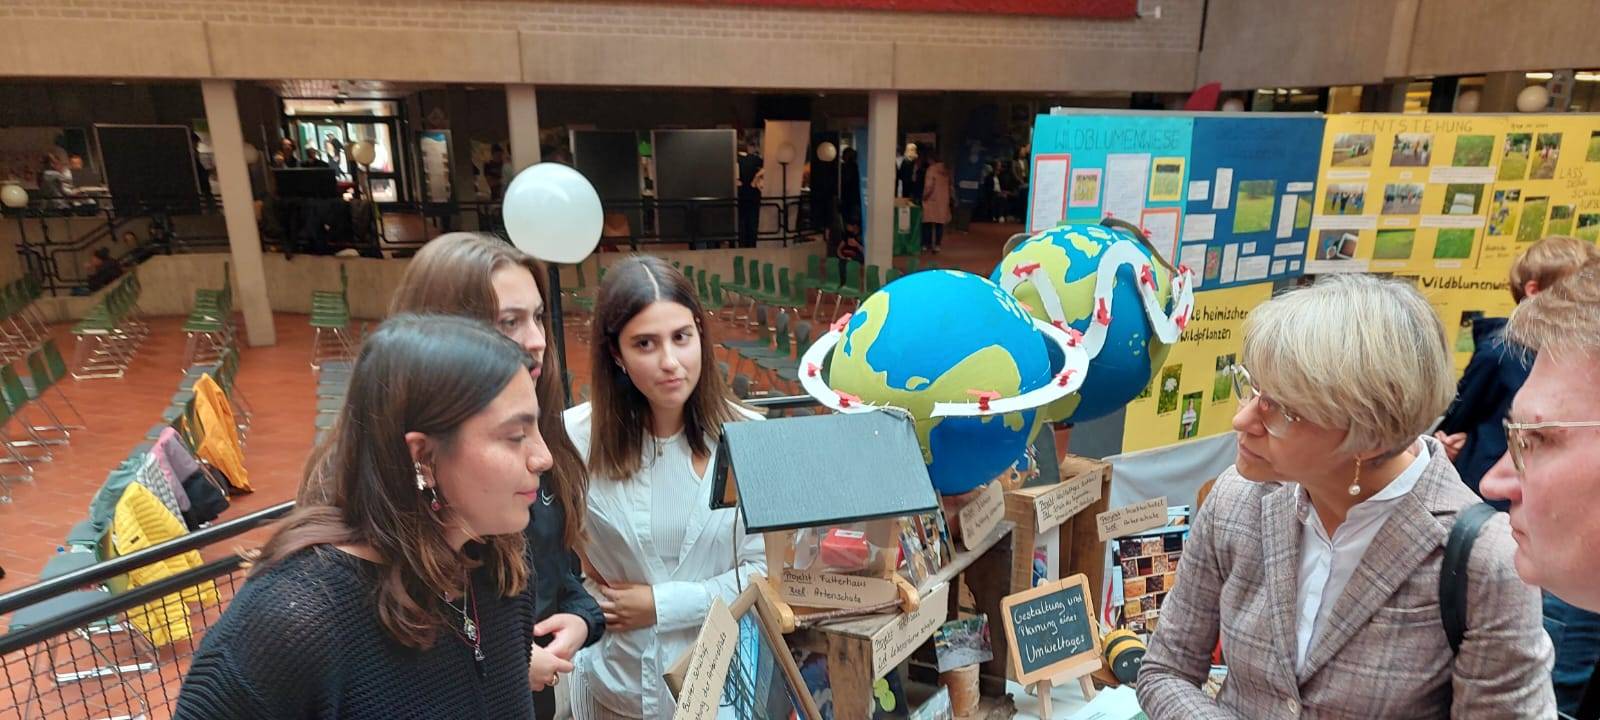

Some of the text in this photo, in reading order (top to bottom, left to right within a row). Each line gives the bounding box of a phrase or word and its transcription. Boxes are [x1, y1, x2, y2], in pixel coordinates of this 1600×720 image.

[1359, 118, 1473, 134] ENTSTEHUNG
[1203, 304, 1248, 321] heimischer
[1180, 327, 1231, 346] Wildpflanzen
[819, 574, 866, 588] Futterhaus
[814, 586, 861, 604] Artenschutz
[1014, 593, 1083, 624] Gestaltung und
[1019, 620, 1058, 637] Planung
